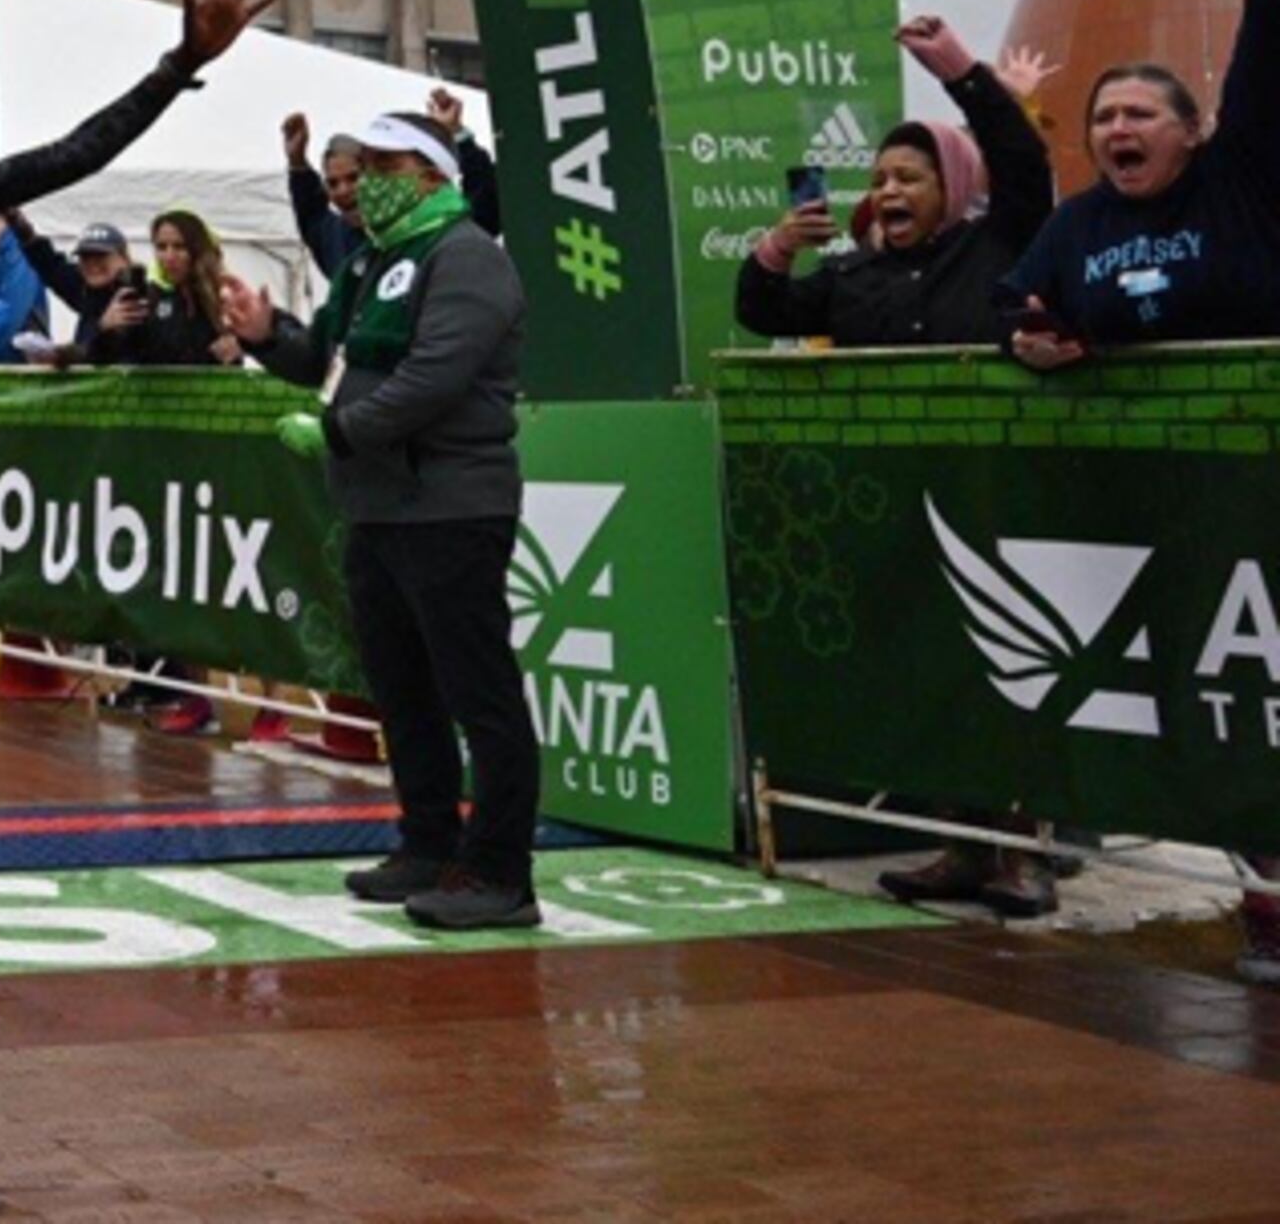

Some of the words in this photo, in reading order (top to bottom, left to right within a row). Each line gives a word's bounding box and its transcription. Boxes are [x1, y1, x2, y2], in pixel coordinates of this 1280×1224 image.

[702, 38, 858, 87] Publix
[720, 136, 775, 162] PNC
[802, 148, 876, 168] adida
[692, 185, 780, 210] DASANI
[562, 756, 671, 806] CLUB
